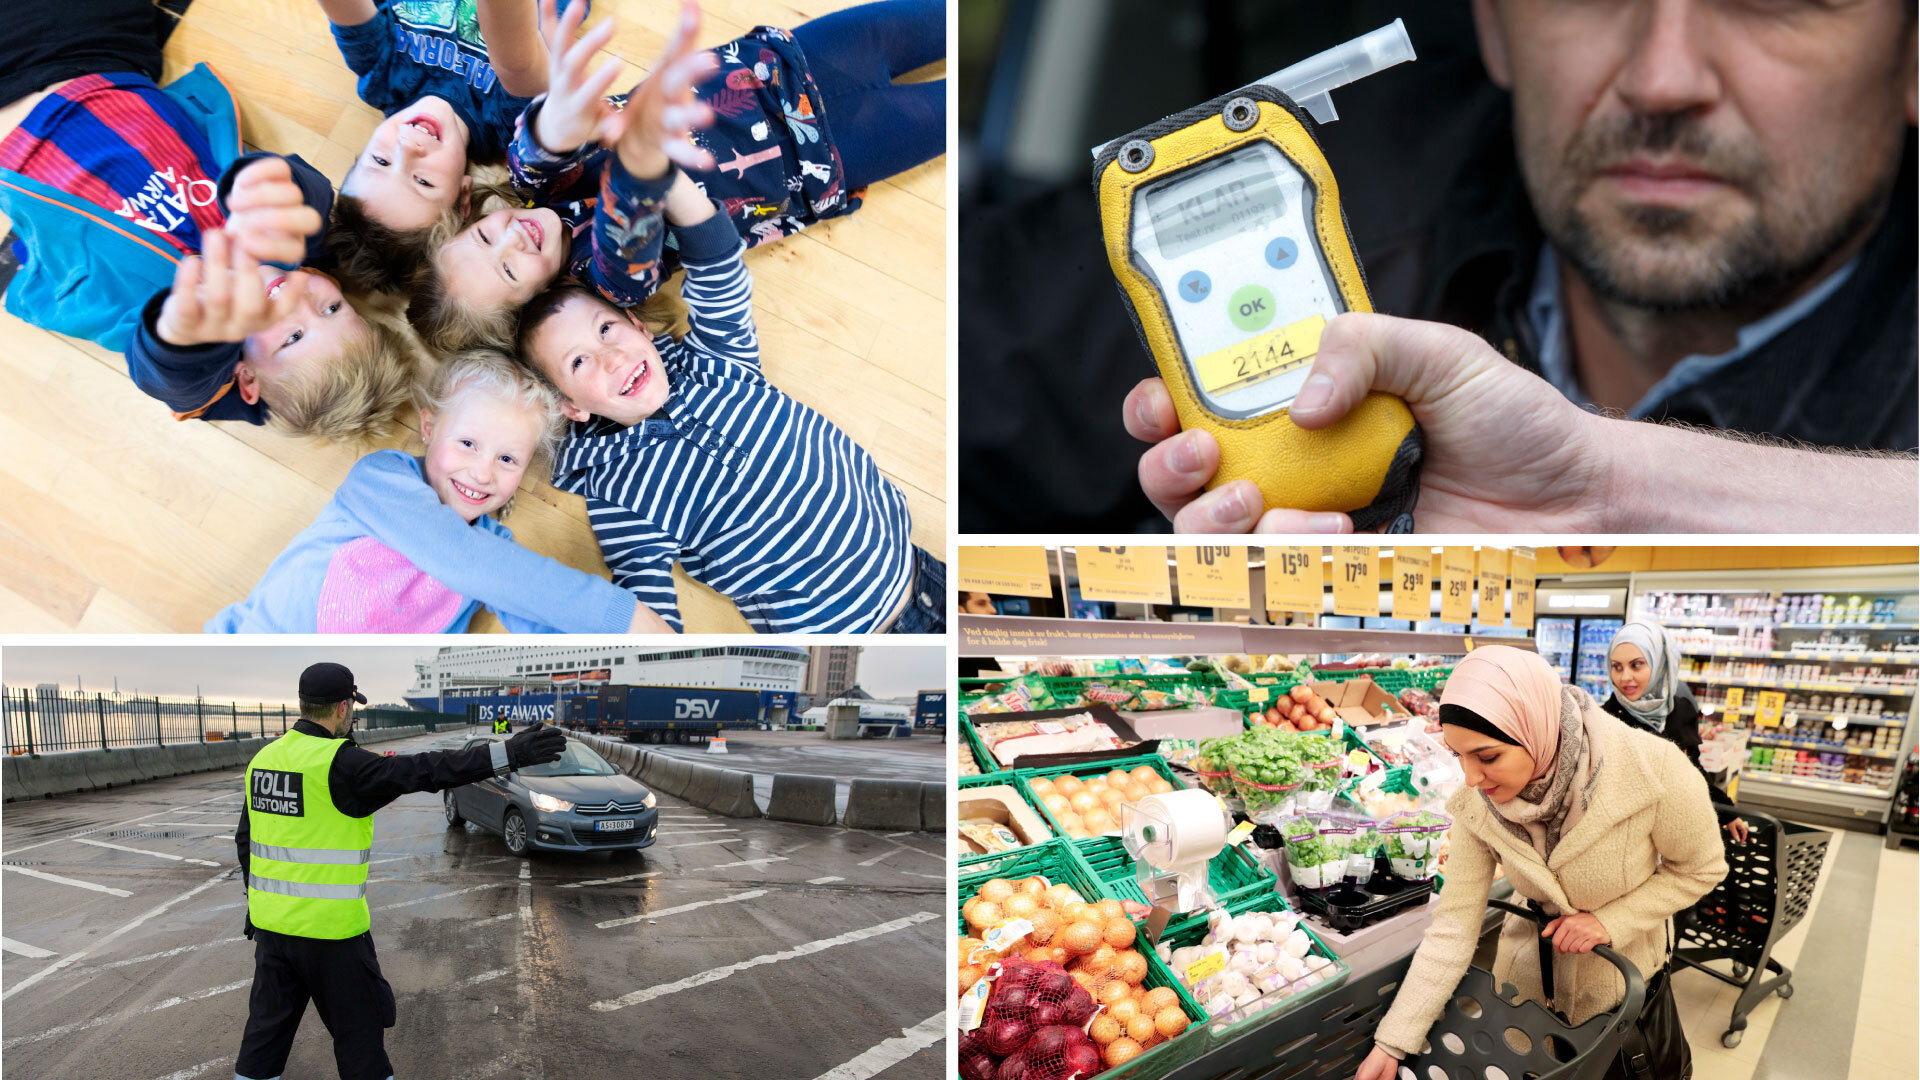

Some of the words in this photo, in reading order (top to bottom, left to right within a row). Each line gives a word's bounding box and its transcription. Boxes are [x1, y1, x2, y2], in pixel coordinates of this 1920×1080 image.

[1179, 180, 1251, 225] KLAR
[1239, 297, 1266, 317] OK
[1232, 340, 1295, 378] 2144
[963, 627, 981, 636] Ved
[982, 628, 1009, 638] daglig
[1082, 632, 1092, 640] og
[966, 636, 979, 645] for
[988, 637, 1011, 646] holde
[1012, 638, 1027, 647] deg
[479, 705, 494, 720] DS
[497, 704, 555, 721] SEAWAYS
[675, 698, 721, 719] DSV
[252, 770, 298, 799] TOLL
[252, 796, 299, 815] CUSTOMS
